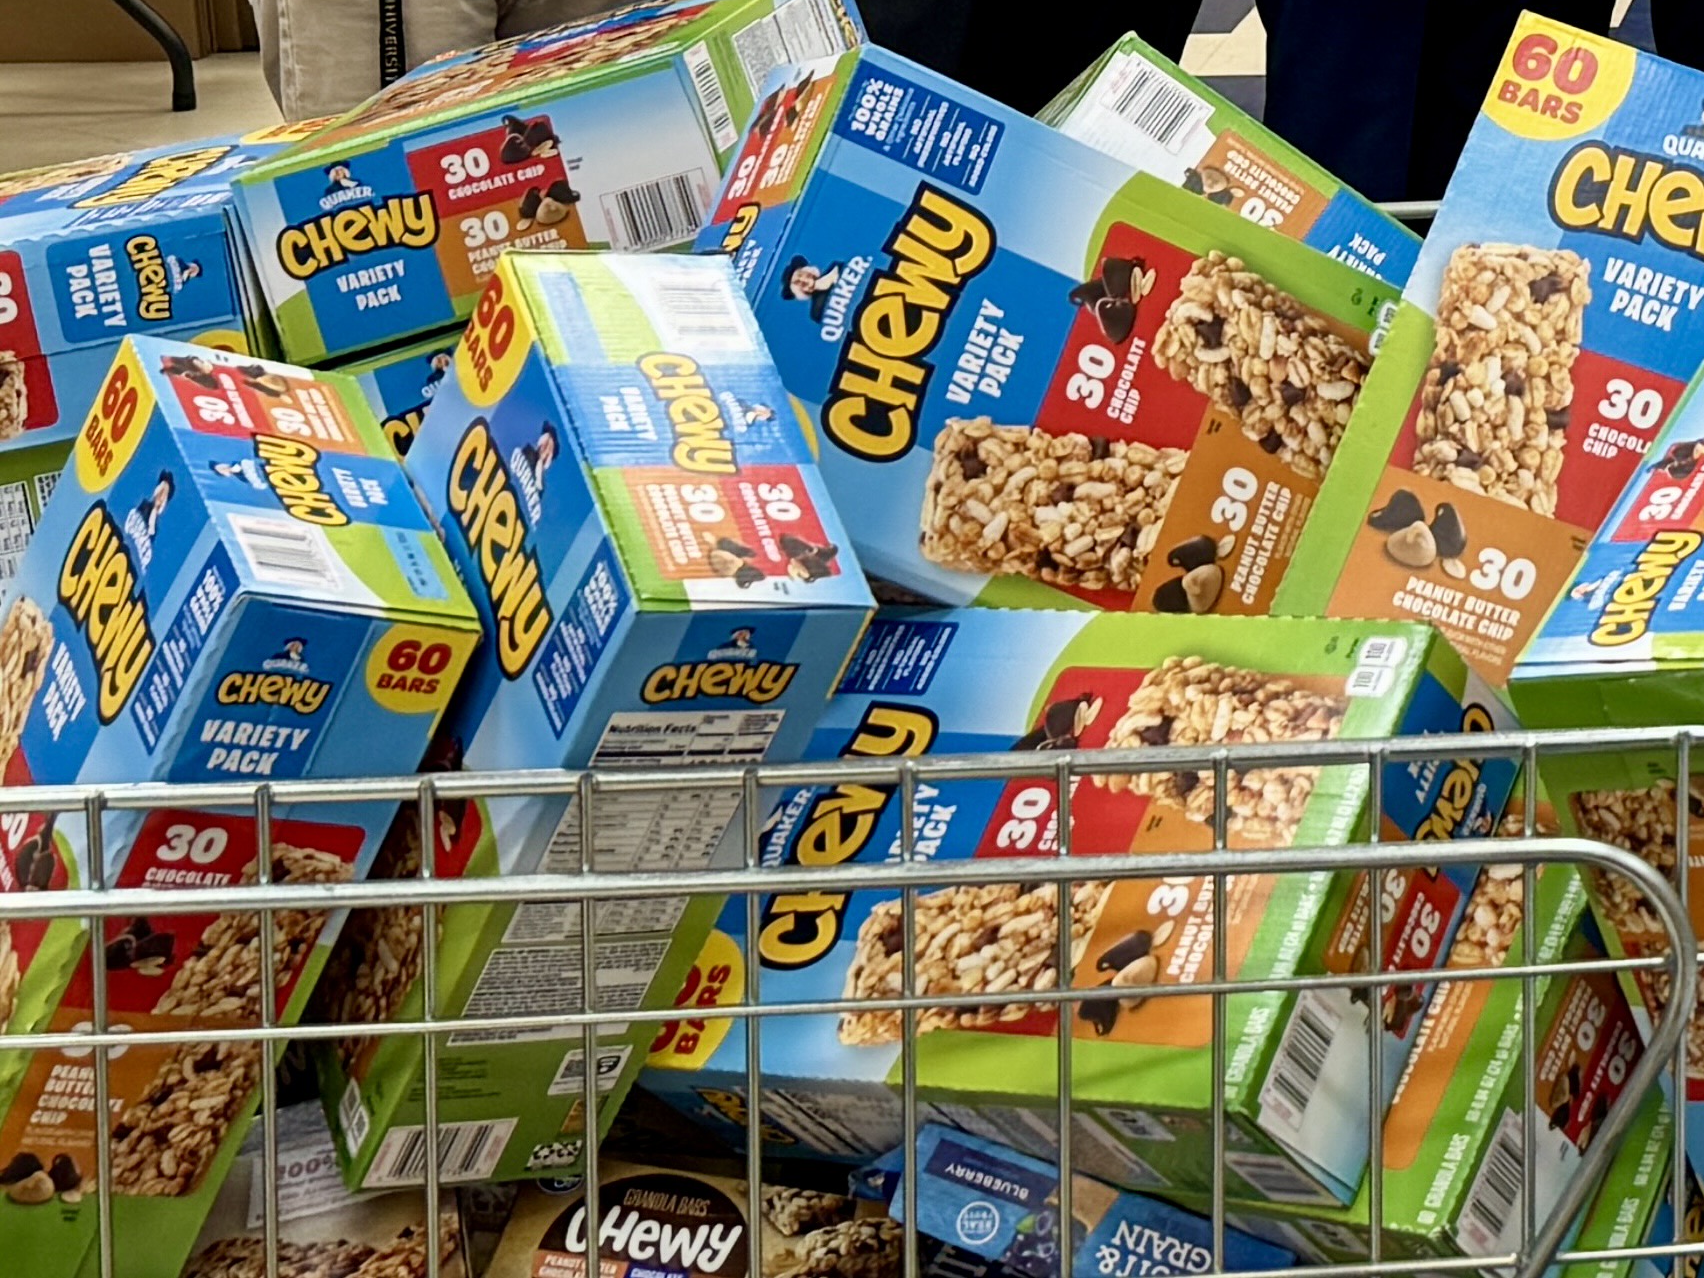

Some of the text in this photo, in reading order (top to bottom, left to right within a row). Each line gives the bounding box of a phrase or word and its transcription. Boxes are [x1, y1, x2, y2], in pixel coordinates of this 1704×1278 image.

[1512, 33, 1598, 95] 60
[1497, 80, 1584, 124] BARS
[440, 147, 491, 184] 30
[448, 164, 546, 200] CHOCOLATE CHIP
[319, 186, 376, 209] QUAKER
[459, 211, 510, 248] 30
[1347, 232, 1387, 267] PACK
[66, 264, 98, 320] PACK
[88, 244, 127, 328] VARIETY
[336, 260, 406, 294] VARIETY
[355, 286, 402, 311] PACK
[820, 254, 871, 343] QUAKER
[475, 273, 515, 362] 60
[1609, 288, 1679, 332] PACK
[945, 297, 1005, 405] VARIETY
[978, 327, 1025, 399] PACK
[1065, 343, 1116, 410] 30
[1107, 337, 1147, 420] CHOCOLATE
[101, 365, 140, 444] 60
[599, 394, 629, 434] PACK
[619, 386, 658, 441] VARIETY
[1119, 387, 1142, 425] CHIP
[1597, 378, 1664, 430] 30
[85, 417, 116, 477] BARS
[1582, 435, 1618, 459] CHIP
[684, 484, 724, 523] 30
[758, 482, 801, 522] 30
[1210, 466, 1258, 532] 30
[1229, 481, 1282, 594] PEANUT BUTTER
[1241, 487, 1292, 606] CHOCOLATE CHIP
[1469, 546, 1537, 601] 30
[1392, 590, 1515, 644] CHOCOLATE CHIP
[1406, 576, 1522, 627] PEANUT BUTTER
[387, 640, 453, 674] 60
[376, 674, 440, 695] BARS
[200, 719, 310, 750] VARIETY
[207, 748, 279, 775] PACK
[997, 786, 1052, 850] 30
[157, 824, 229, 865] 30
[944, 1161, 1031, 1201] BLUEBERRY
